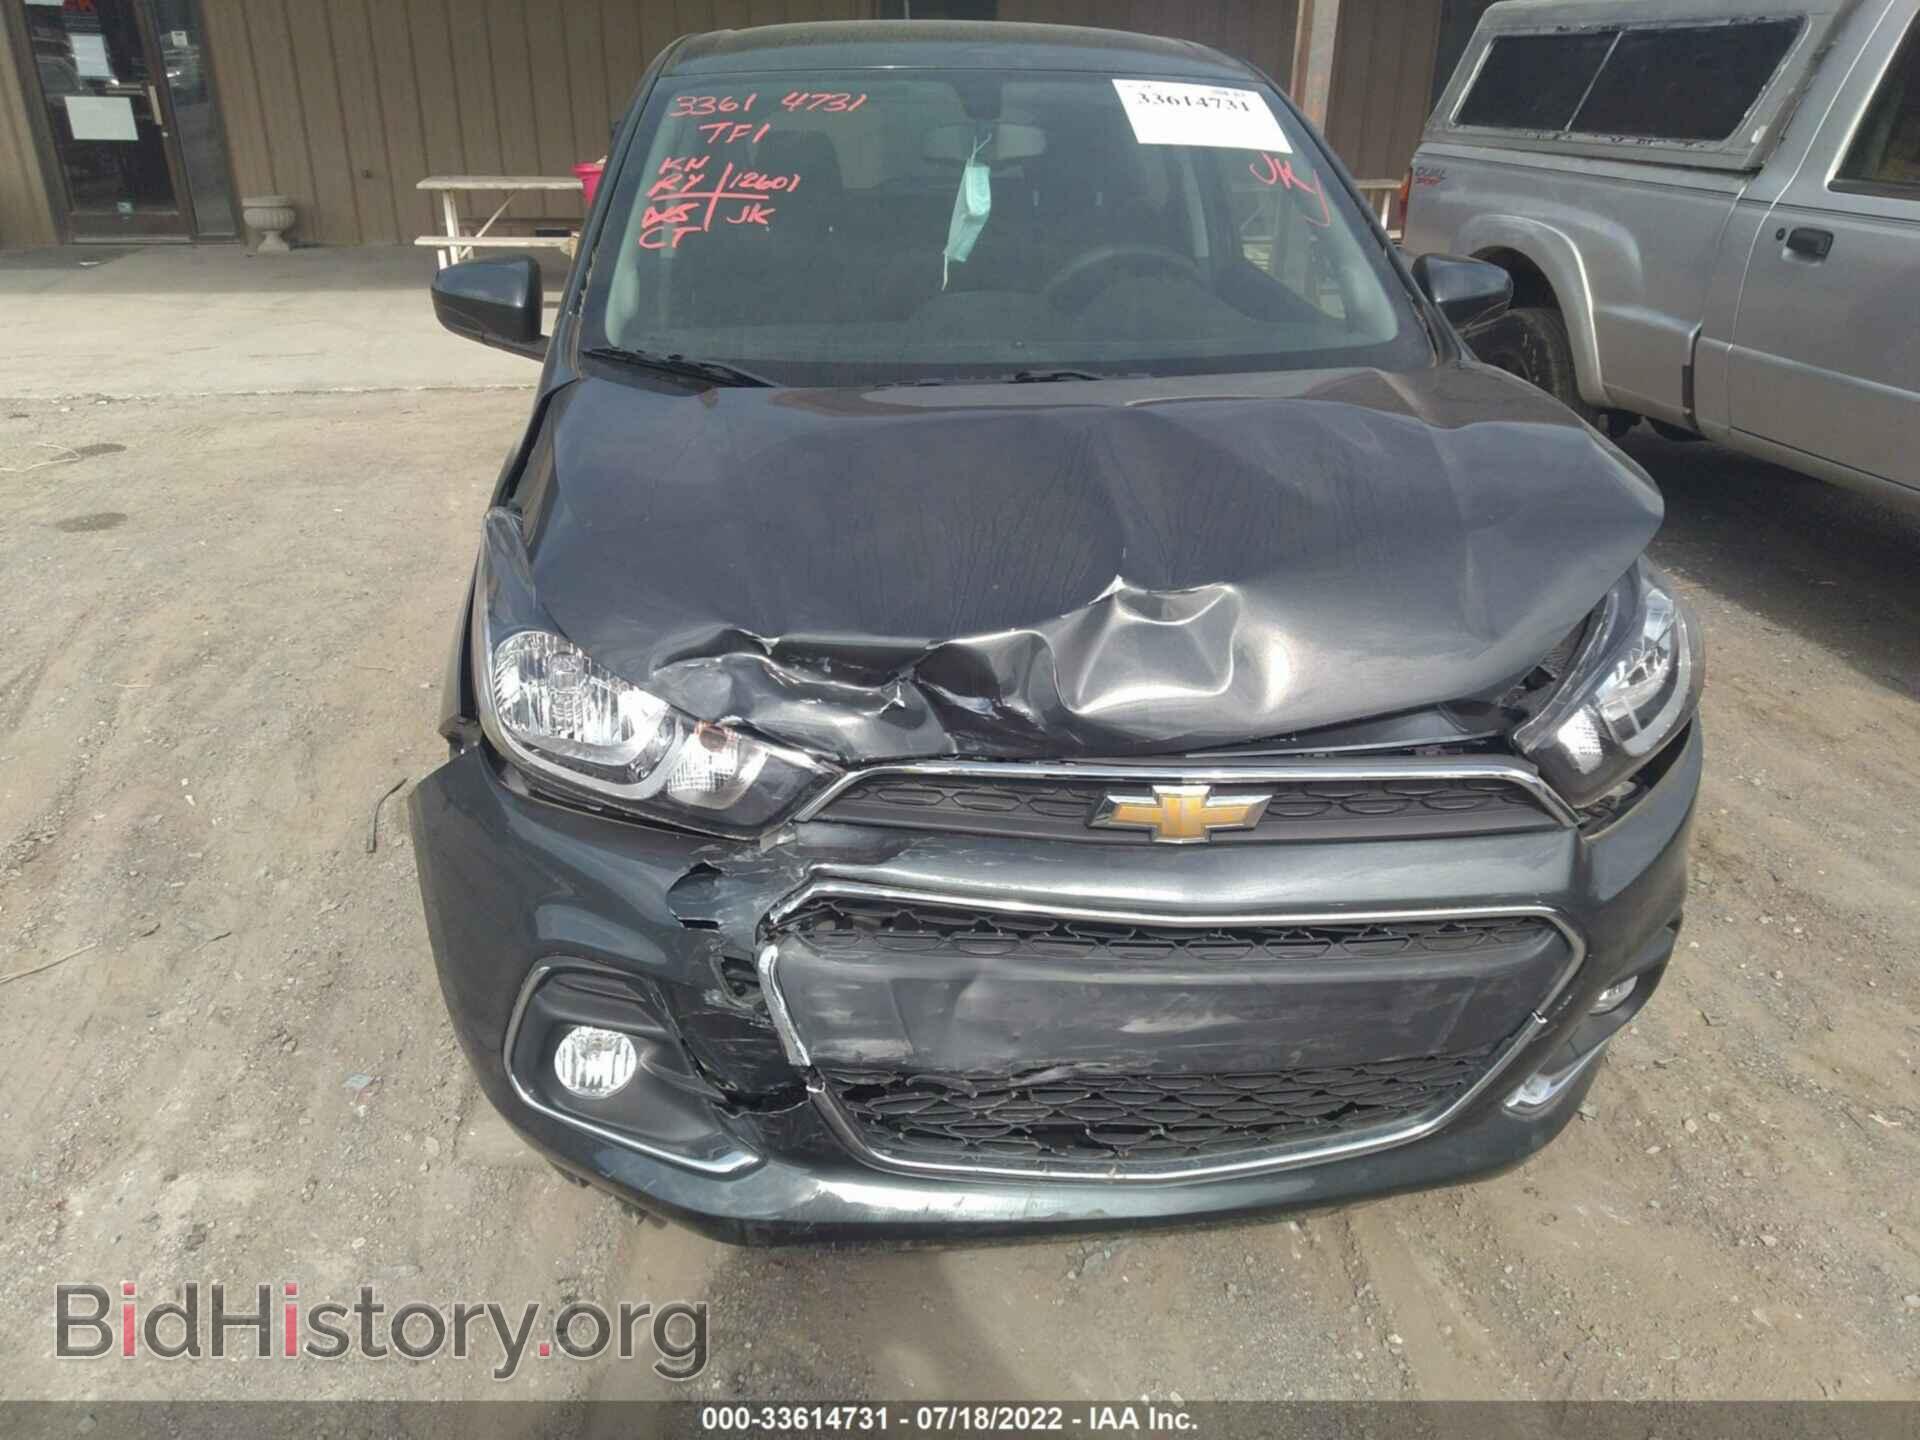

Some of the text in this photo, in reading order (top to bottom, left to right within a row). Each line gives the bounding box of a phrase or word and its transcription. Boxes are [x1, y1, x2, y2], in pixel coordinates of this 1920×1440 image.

[669, 91, 867, 117] 3361 4731
[1137, 91, 1250, 112] 33614731
